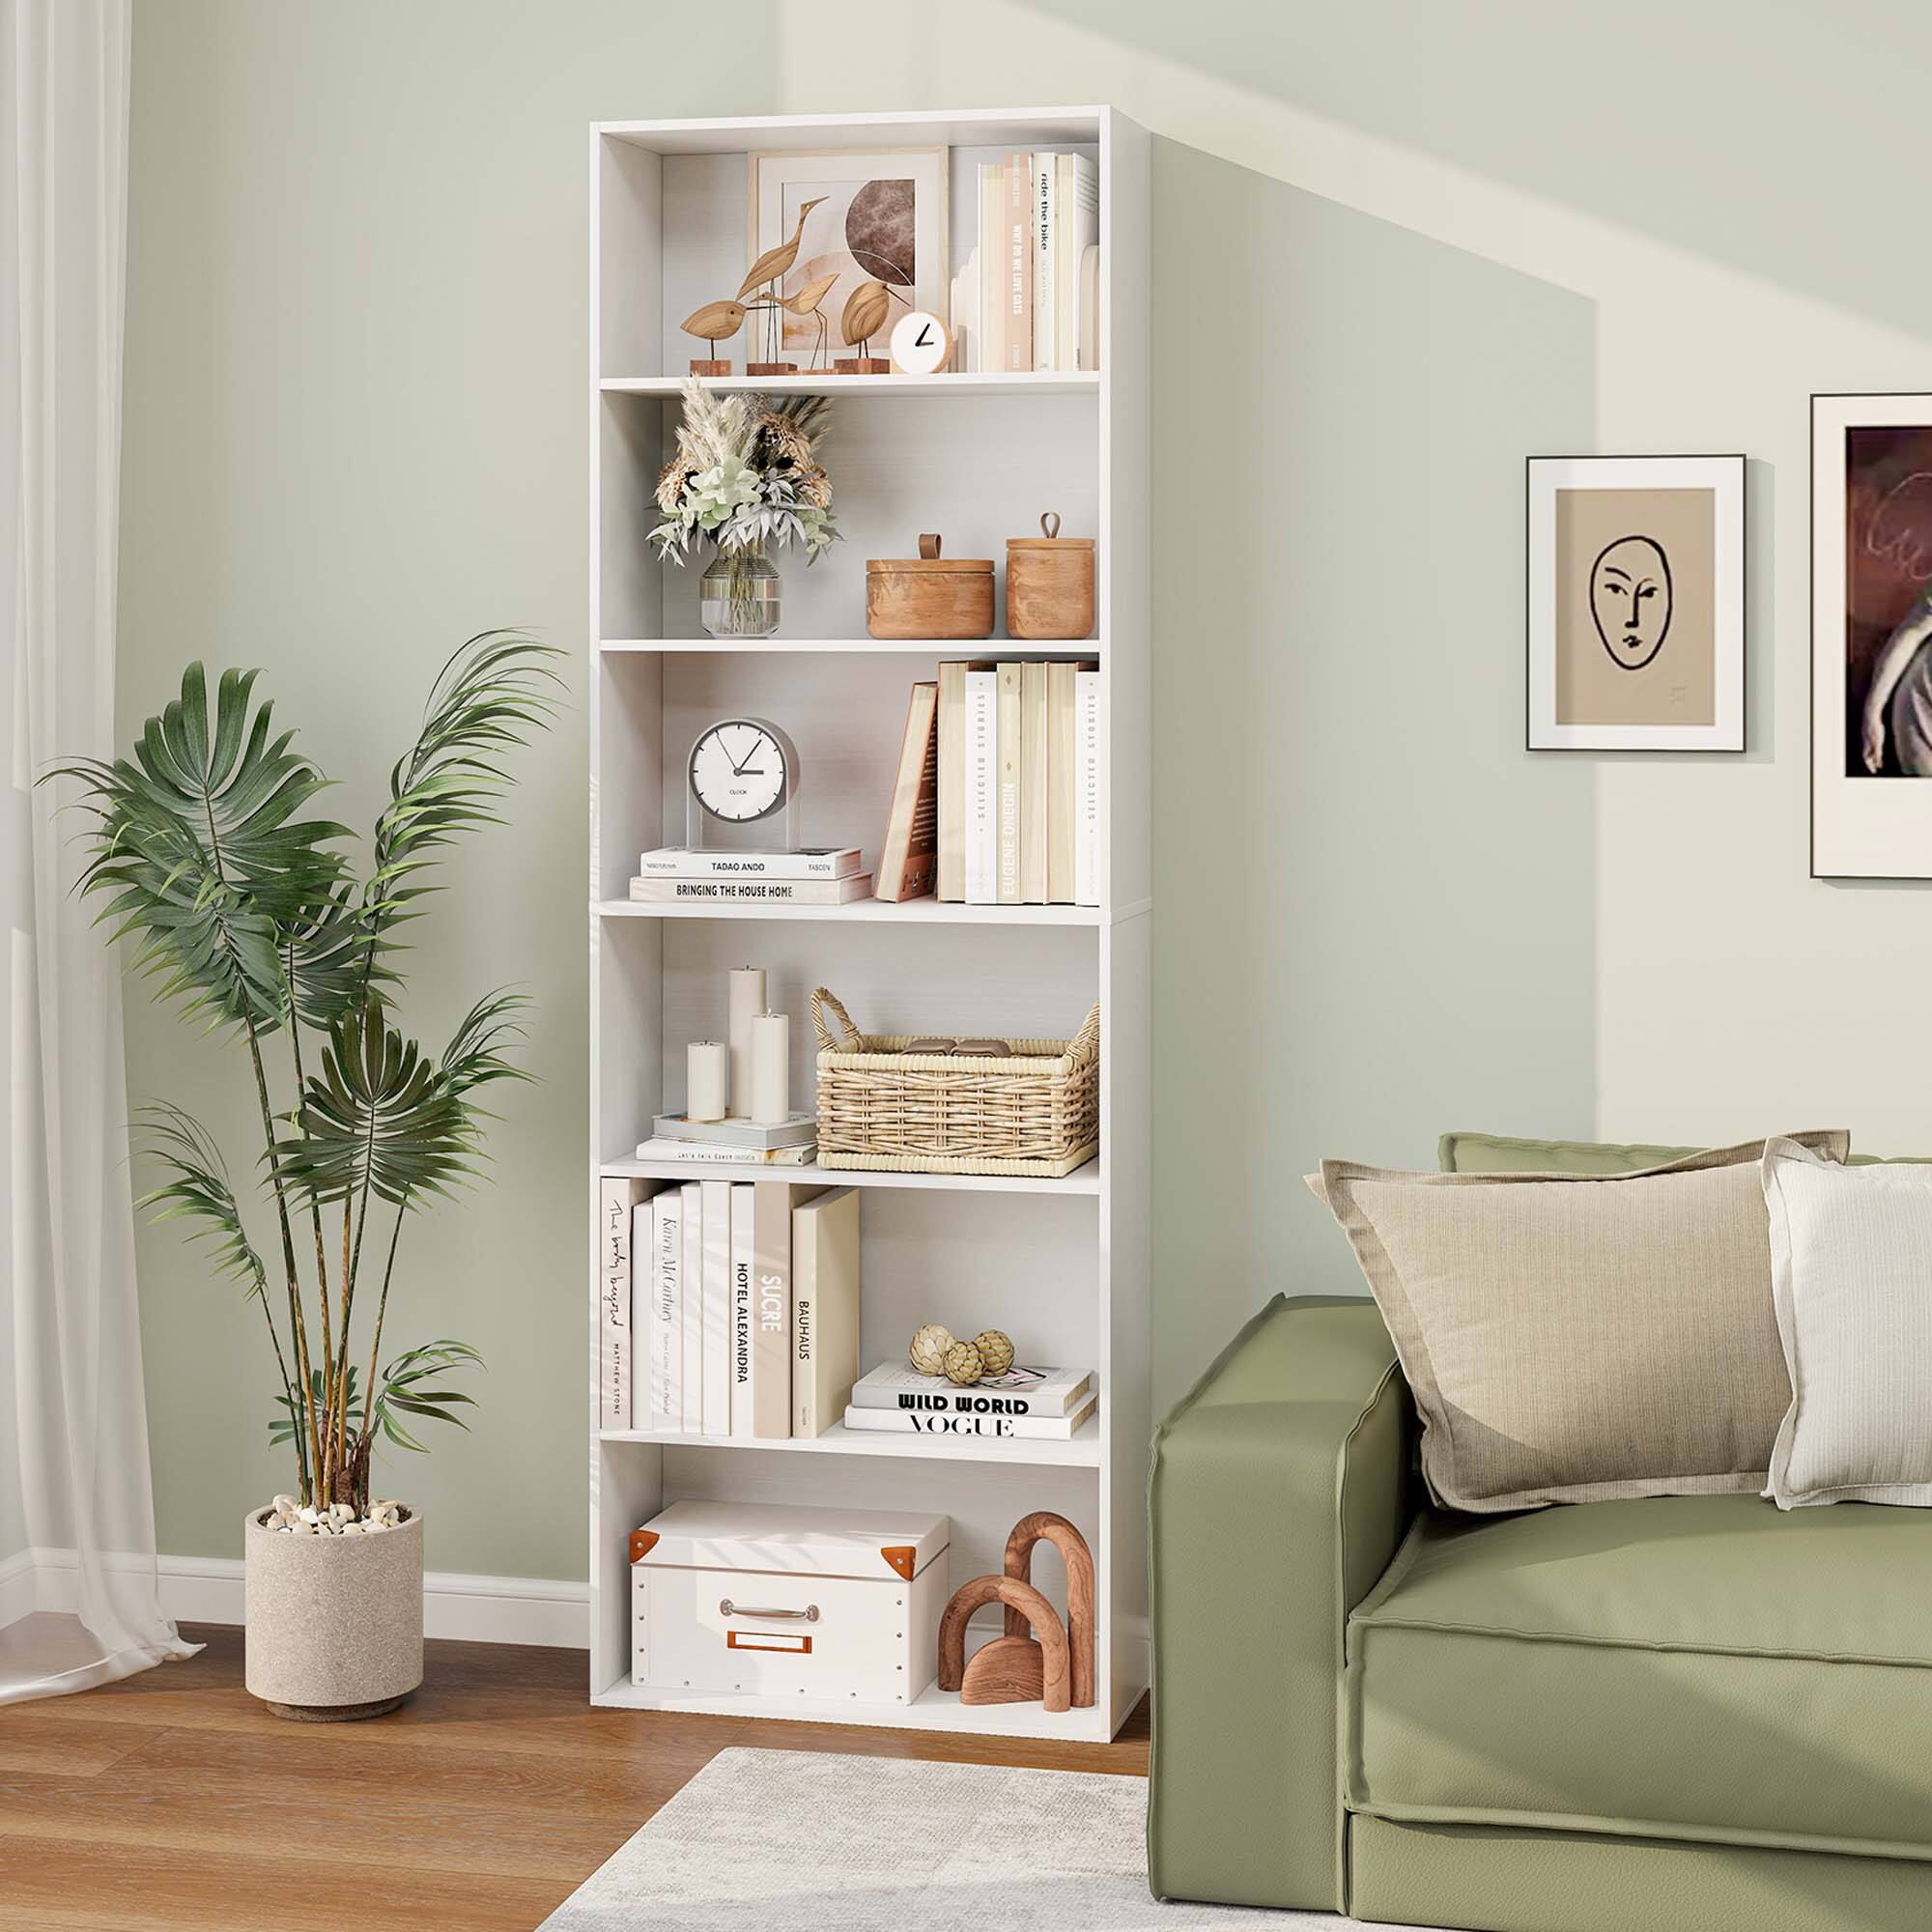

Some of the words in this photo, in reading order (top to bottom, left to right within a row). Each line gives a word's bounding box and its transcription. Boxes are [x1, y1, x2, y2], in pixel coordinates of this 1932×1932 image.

[711, 862, 740, 871] TADAO
[741, 863, 765, 872] ANDO
[1003, 839, 1014, 895] EUGENE
[676, 884, 718, 896] BRINGING
[719, 885, 736, 897] THE
[738, 885, 767, 897] HOUSE
[768, 886, 793, 897] HOME
[610, 1199, 624, 1232] The
[609, 1236, 627, 1269] body
[662, 1217, 677, 1254] Karen
[603, 1275, 625, 1327] beyond
[737, 1263, 749, 1304] HOTEL
[760, 1274, 782, 1332] SUCRE
[737, 1306, 749, 1383] ALEXANDRA
[798, 1300, 810, 1361] BAUHAUS
[897, 1393, 949, 1411] WILD
[954, 1396, 1030, 1415] WORLD
[909, 1414, 1014, 1437] VOGUE
